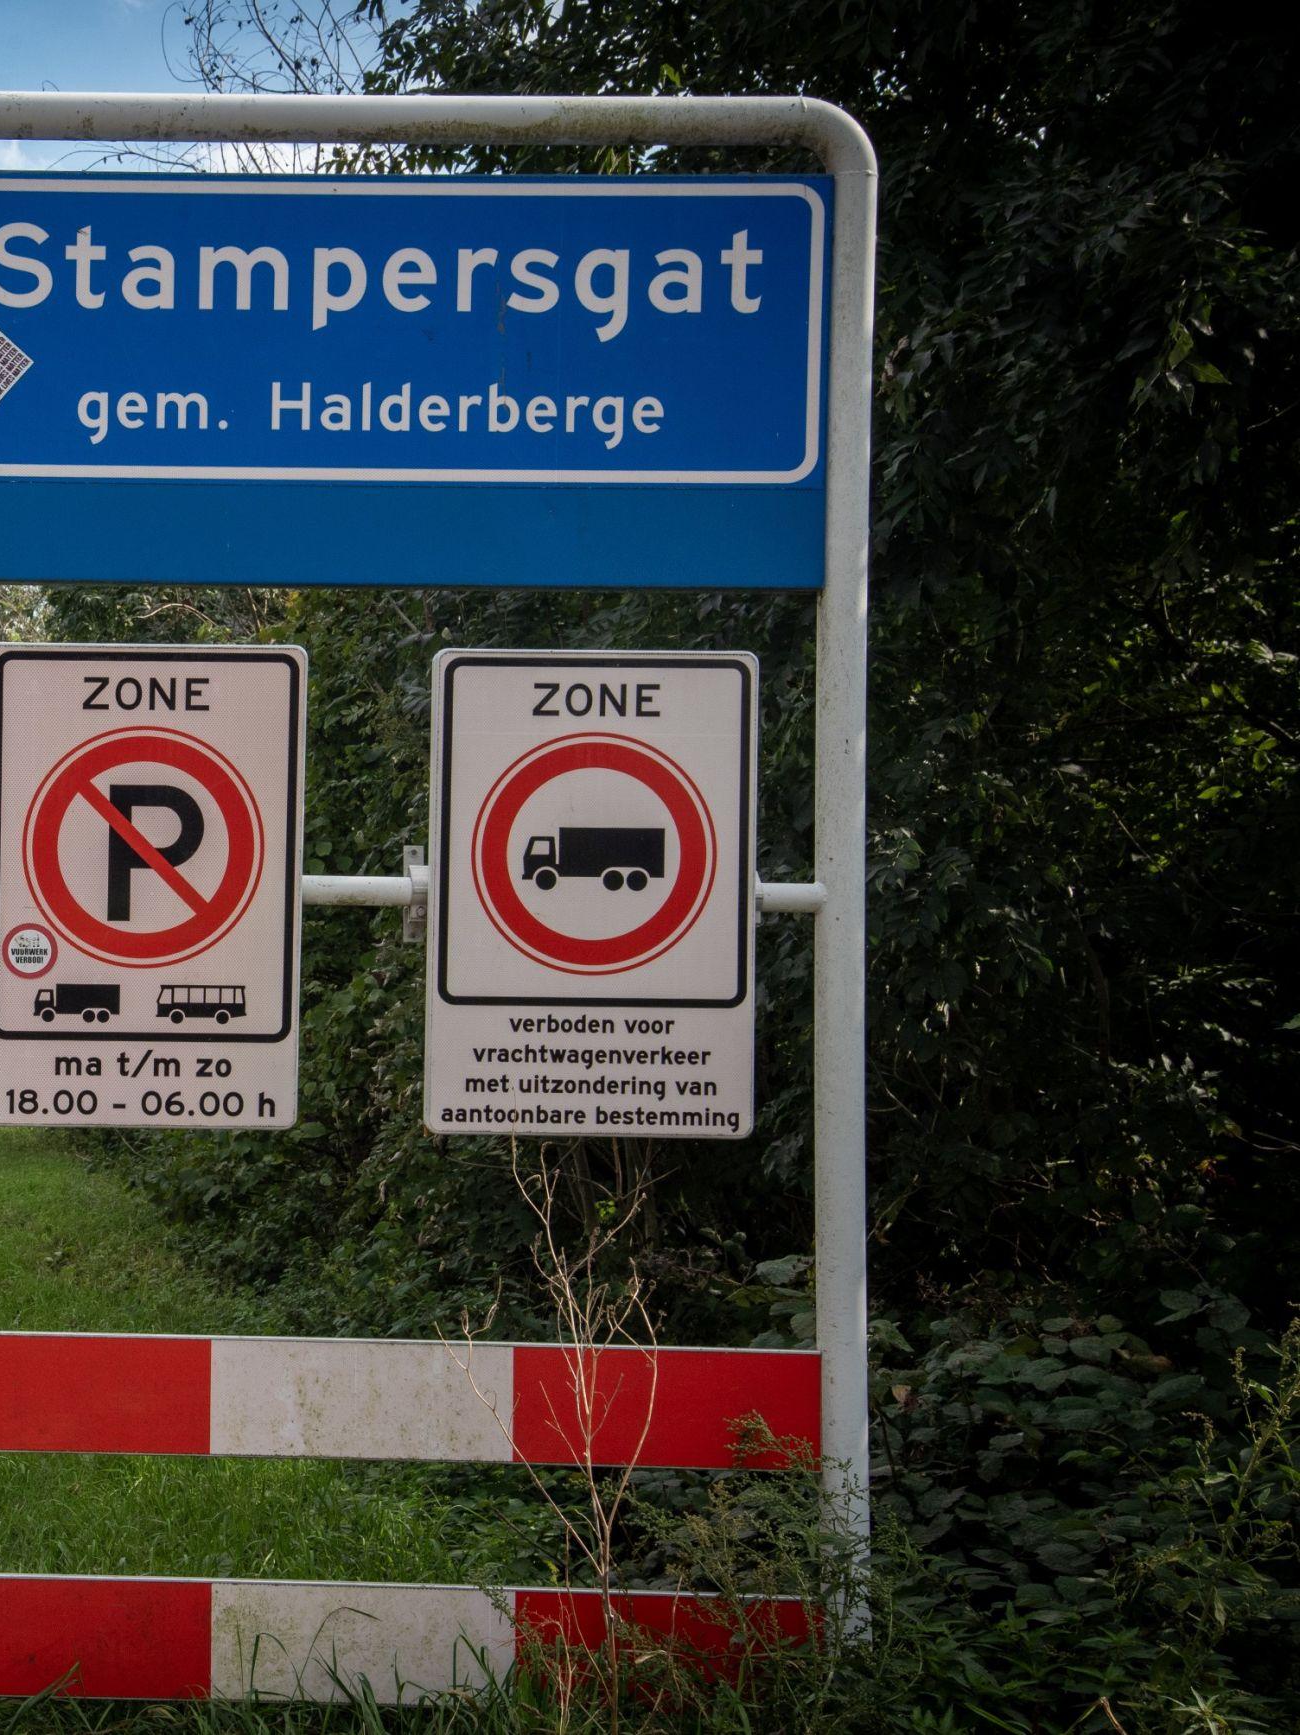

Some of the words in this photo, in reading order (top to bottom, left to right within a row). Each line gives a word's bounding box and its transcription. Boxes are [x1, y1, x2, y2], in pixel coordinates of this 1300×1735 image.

[0, 347, 18, 366] MATTER
[6, 353, 24, 371] MATTER
[2, 375, 15, 389] LIVES
[12, 358, 30, 377] MATTER
[78, 392, 227, 444] gem.
[272, 382, 664, 449] Halderberge
[83, 677, 209, 711] ZONE
[533, 683, 660, 717] ZONE
[107, 785, 205, 922] P
[510, 1014, 614, 1033] verboden
[624, 1020, 674, 1034] voor
[55, 1057, 101, 1076] ma
[117, 1050, 180, 1077] t/m
[196, 1059, 231, 1077] zo
[473, 1045, 711, 1068] vrachtwagenverkeer
[466, 1075, 509, 1093] met
[519, 1075, 665, 1101] uitzondering
[676, 1081, 716, 1095] van
[6, 1089, 97, 1115] 18.00
[142, 1091, 243, 1116] 06.00
[259, 1092, 275, 1117] h
[442, 1105, 586, 1124] aantoonbare
[596, 1106, 740, 1132] bestemming
